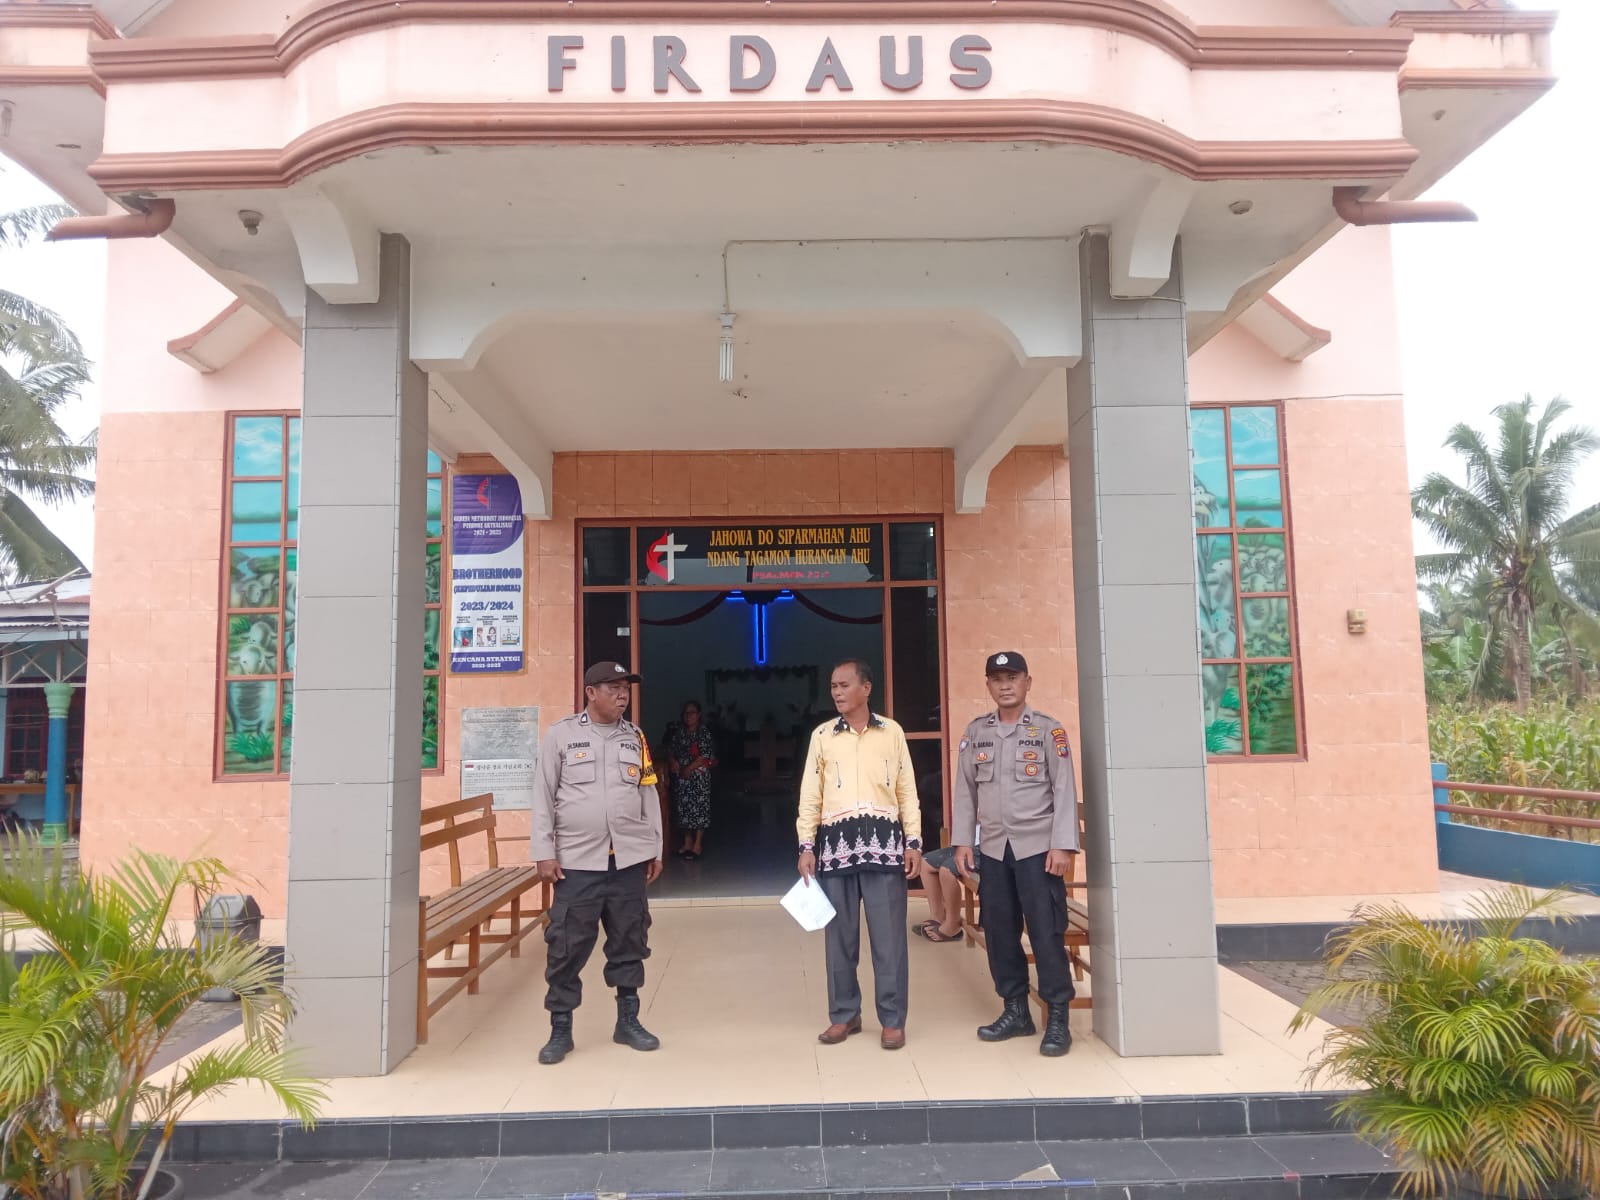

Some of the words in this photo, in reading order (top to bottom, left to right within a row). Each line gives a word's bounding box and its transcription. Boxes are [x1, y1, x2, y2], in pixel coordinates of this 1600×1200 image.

[547, 34, 992, 93] FIRDAUS
[709, 529, 753, 546] JAHOWA
[758, 529, 774, 545] DO
[777, 527, 845, 545] SIPARMAHAN
[849, 527, 871, 544] AHU
[707, 550, 740, 567] NDANG
[744, 549, 791, 567] TAGAMON
[794, 548, 847, 566] HURANGAN
[850, 547, 871, 564] AHU
[453, 567, 522, 580] BROTHERHOOD
[460, 601, 514, 611] 2023/2024
[1019, 739, 1044, 747] POLRI
